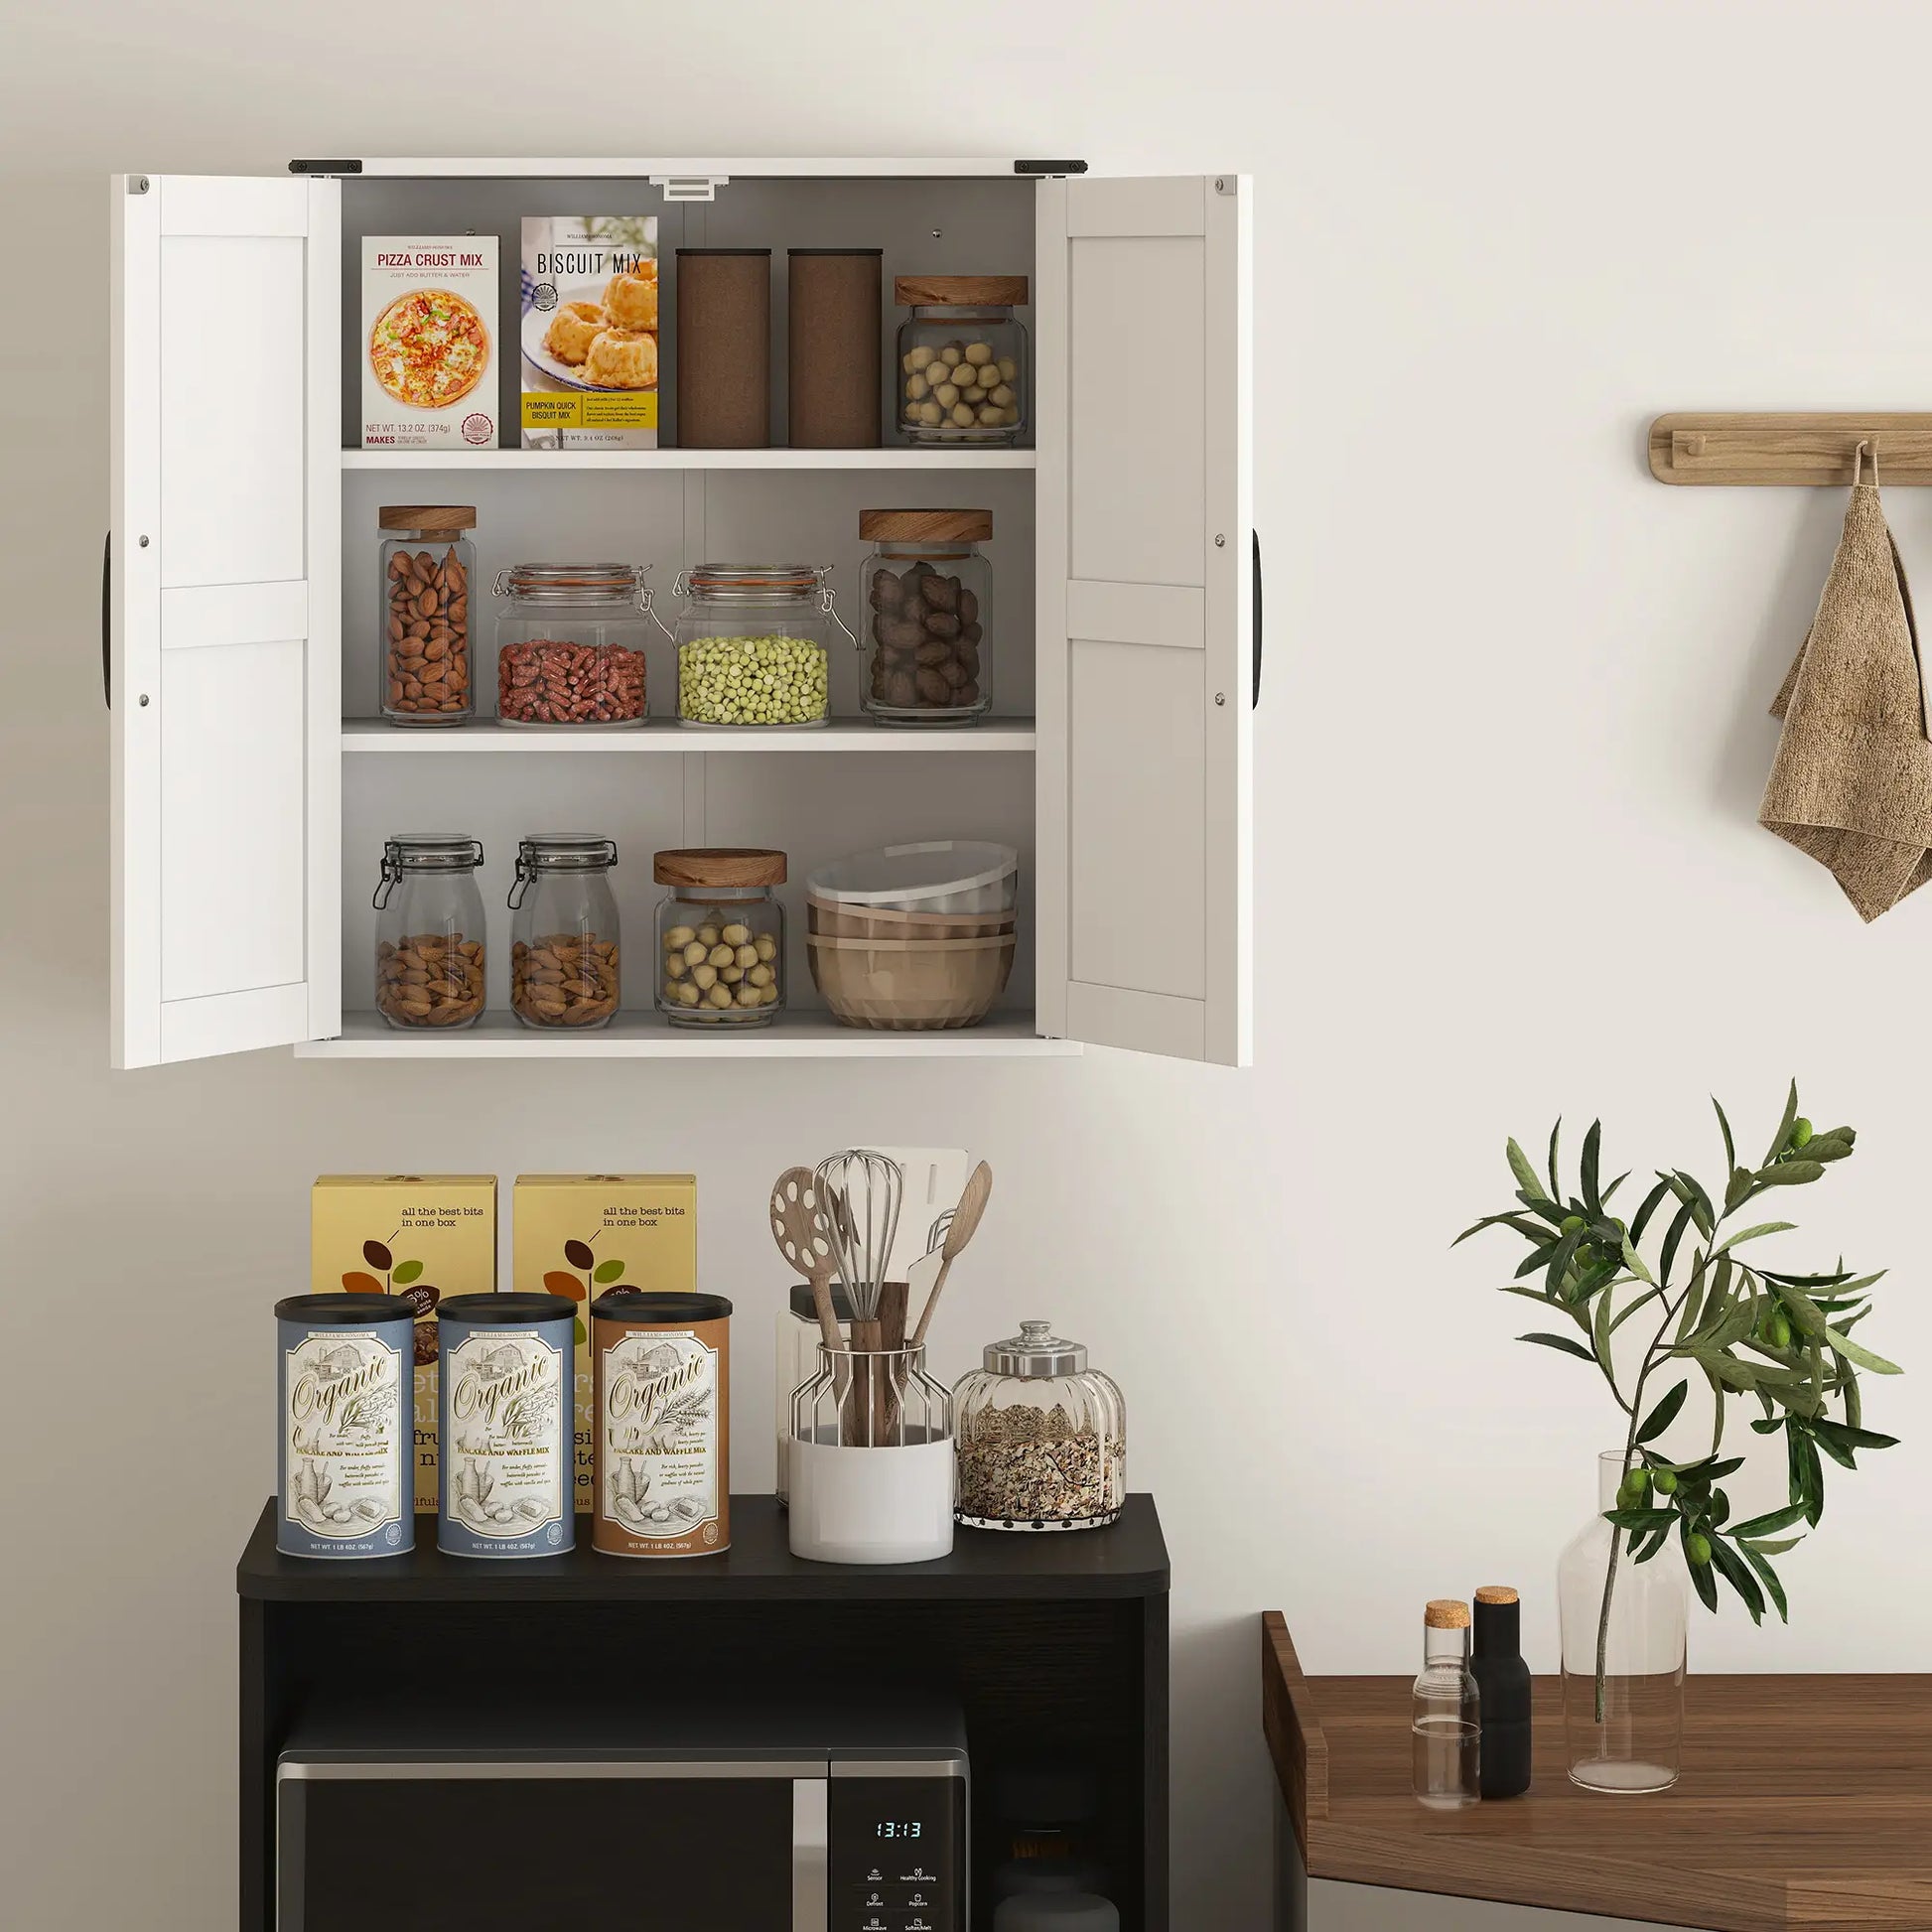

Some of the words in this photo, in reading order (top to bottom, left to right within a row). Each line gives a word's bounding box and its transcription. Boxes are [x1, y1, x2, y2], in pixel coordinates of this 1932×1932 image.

[377, 254, 412, 266] PIZZA
[415, 254, 456, 266] CRUST
[460, 254, 483, 266] MIX
[537, 253, 604, 274] BISCUIT
[613, 253, 641, 274] MIX
[428, 424, 451, 434] (374g)
[401, 1207, 416, 1216] all
[418, 1207, 437, 1216] the
[438, 1207, 462, 1216] best
[463, 1207, 483, 1216] bits
[401, 1218, 413, 1227] in
[437, 1218, 457, 1227] box
[292, 1355, 387, 1426] Organic
[454, 1355, 548, 1425] Organic
[609, 1354, 705, 1424] Organic
[877, 1822, 921, 1838] 13:13
